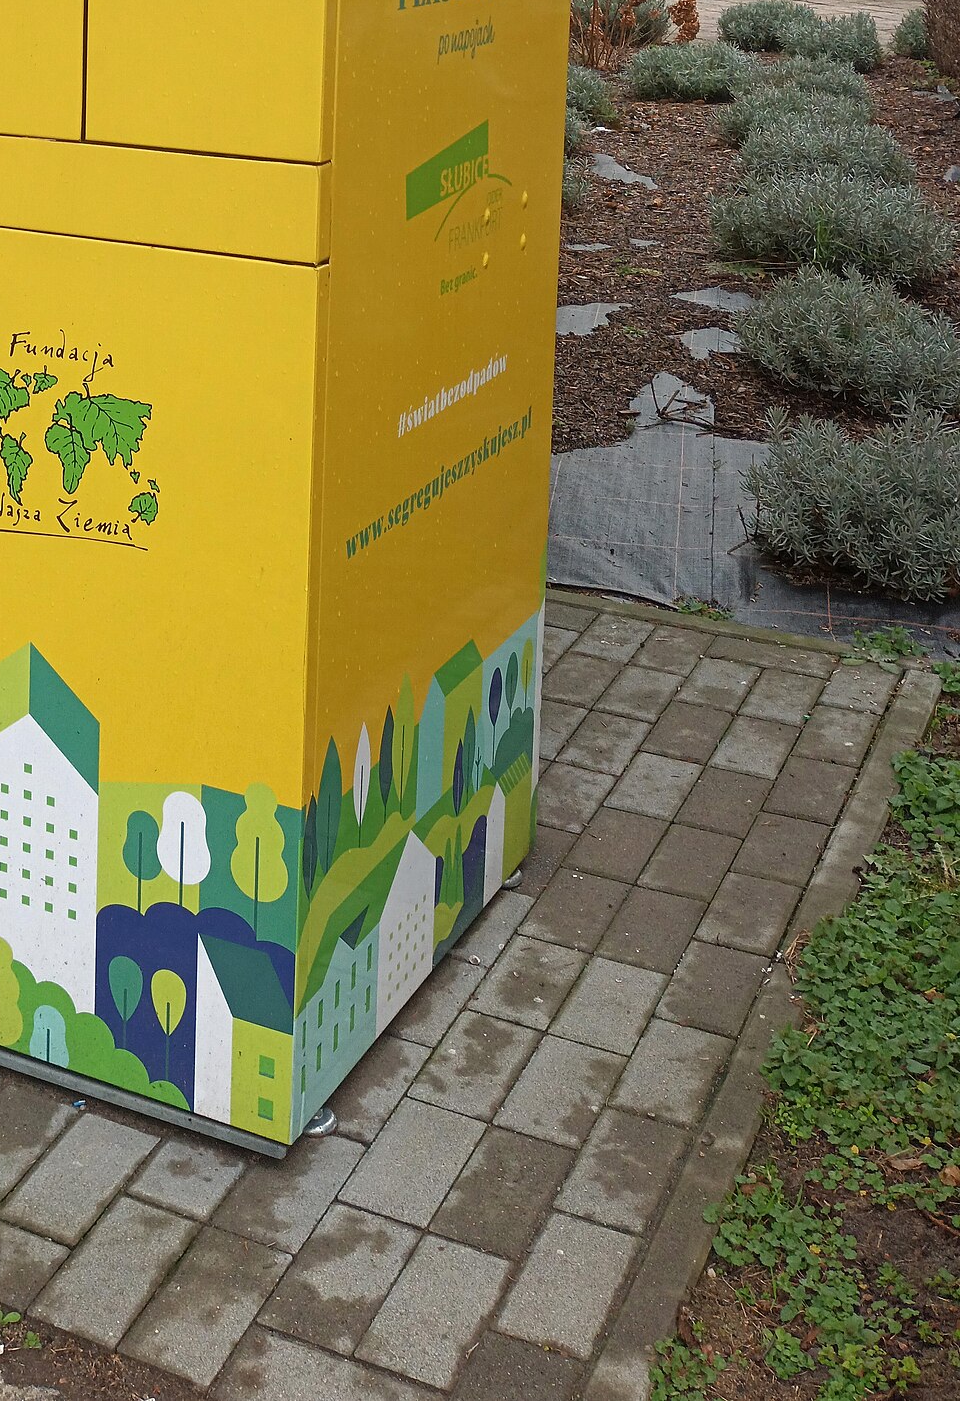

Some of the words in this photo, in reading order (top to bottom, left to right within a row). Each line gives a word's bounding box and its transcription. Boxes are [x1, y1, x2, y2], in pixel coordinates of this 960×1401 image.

[437, 33, 450, 65] po
[451, 14, 495, 60] napojach
[440, 154, 489, 197] SŁUBICE
[440, 276, 453, 295] Bez
[9, 329, 114, 382] Fundacja
[397, 352, 508, 438] #światbezodpadów
[346, 406, 532, 559] www.segregujeszzyskujesz.pl
[56, 498, 133, 540] Ziemia
